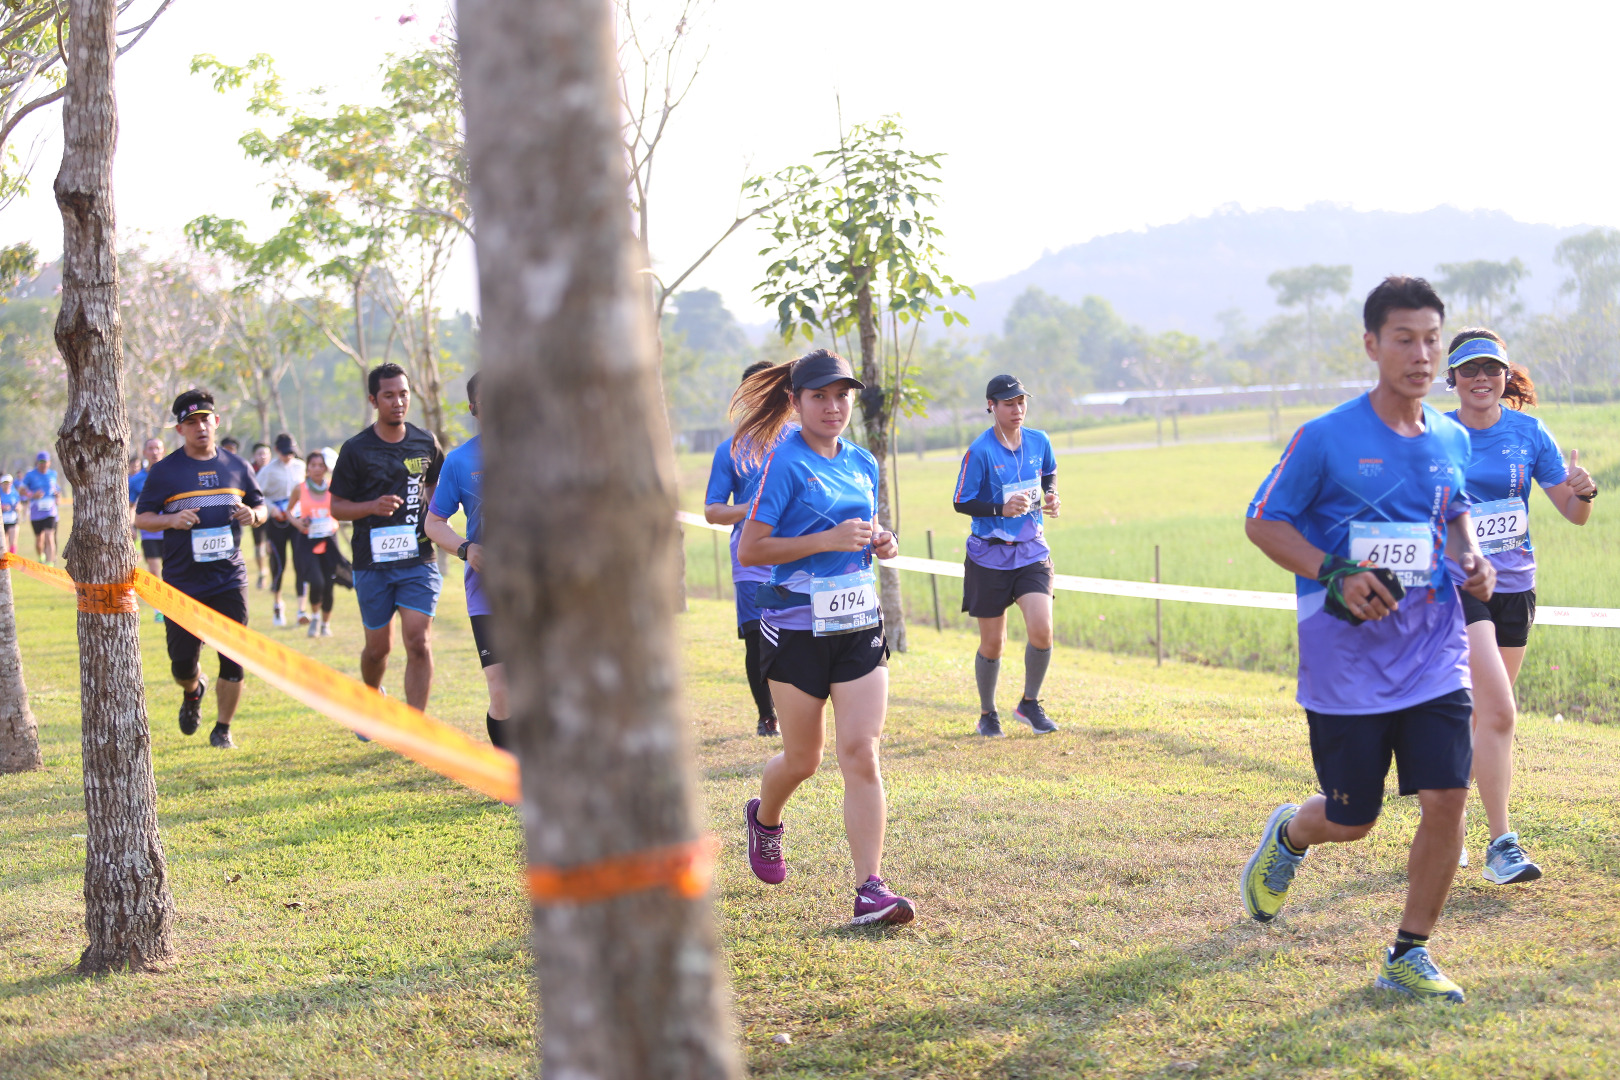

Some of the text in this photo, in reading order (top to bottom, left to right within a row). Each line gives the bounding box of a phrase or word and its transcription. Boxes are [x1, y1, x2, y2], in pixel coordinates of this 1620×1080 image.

[1509, 463, 1517, 488] CROSS
[1432, 485, 1442, 515] CROSS
[1476, 515, 1517, 537] 6232
[202, 537, 227, 550] 6015
[381, 537, 409, 550] 6276
[1368, 544, 1416, 564] 6158
[829, 590, 865, 612] 6194
